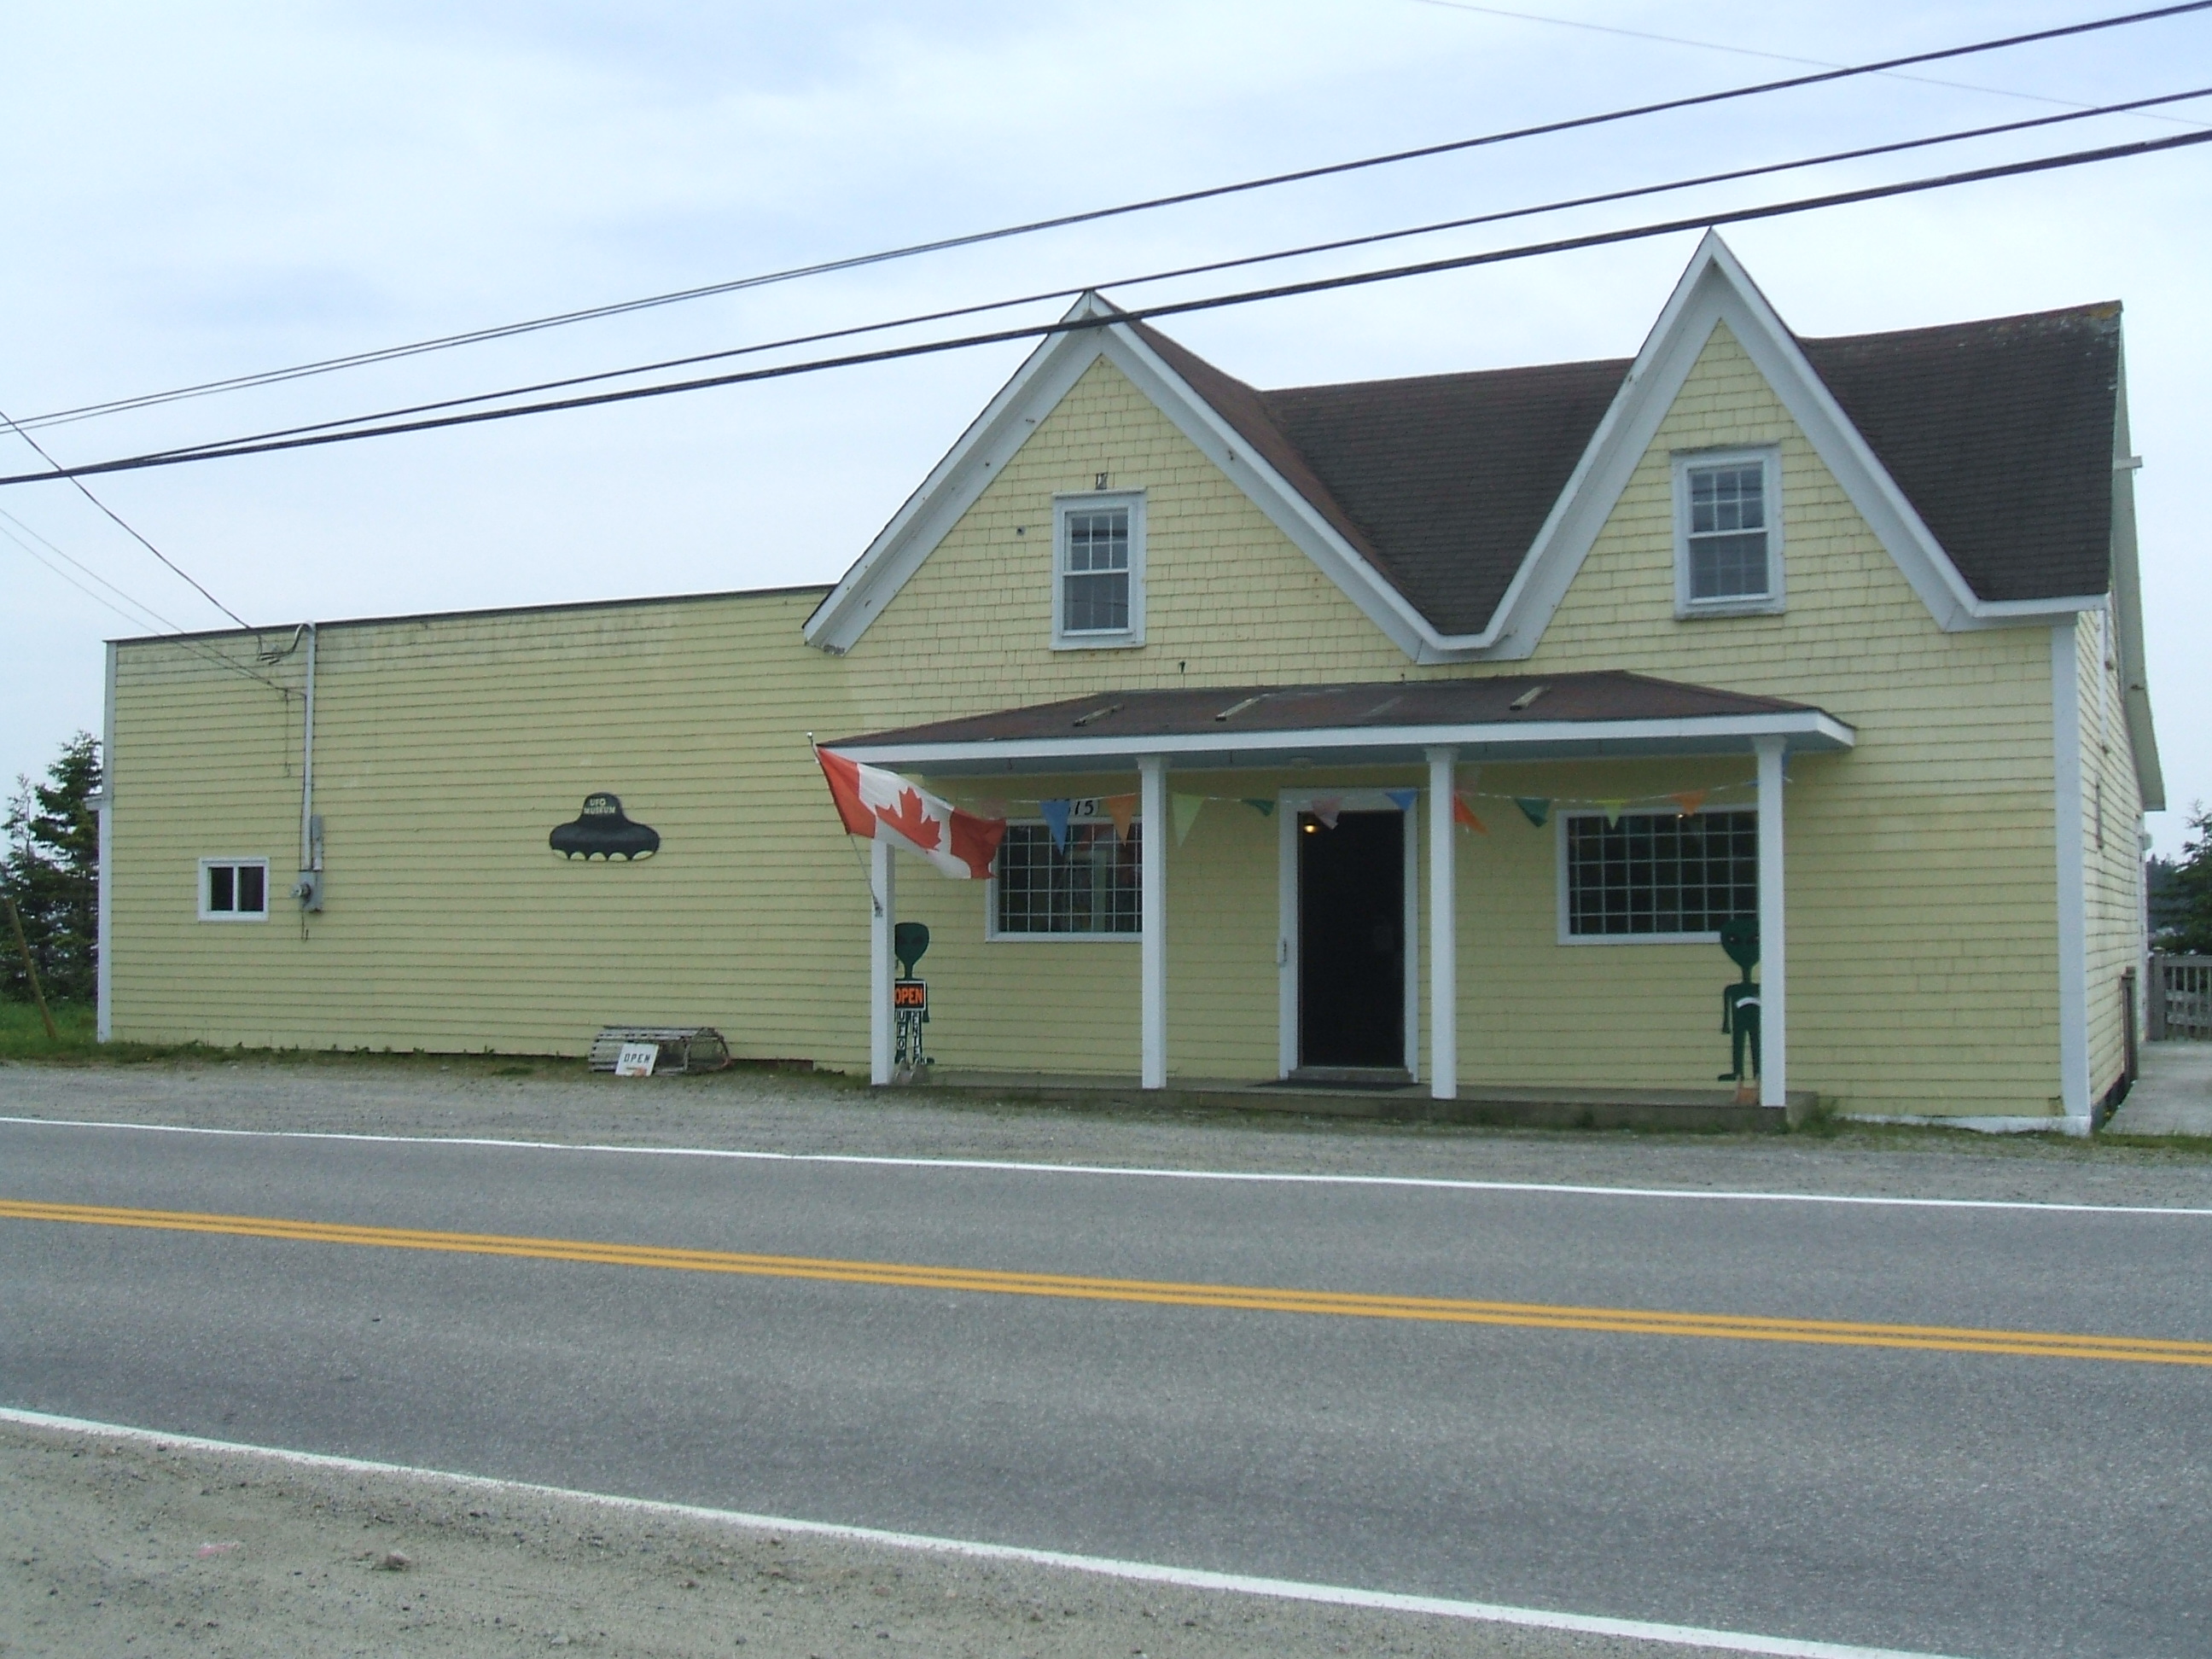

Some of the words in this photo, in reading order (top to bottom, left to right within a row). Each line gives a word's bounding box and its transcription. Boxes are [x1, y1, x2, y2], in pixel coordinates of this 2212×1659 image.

[590, 798, 606, 806] UFO
[584, 806, 616, 815] MUSEUM
[894, 987, 923, 1005] OPEN
[623, 1053, 651, 1063] OPEN
